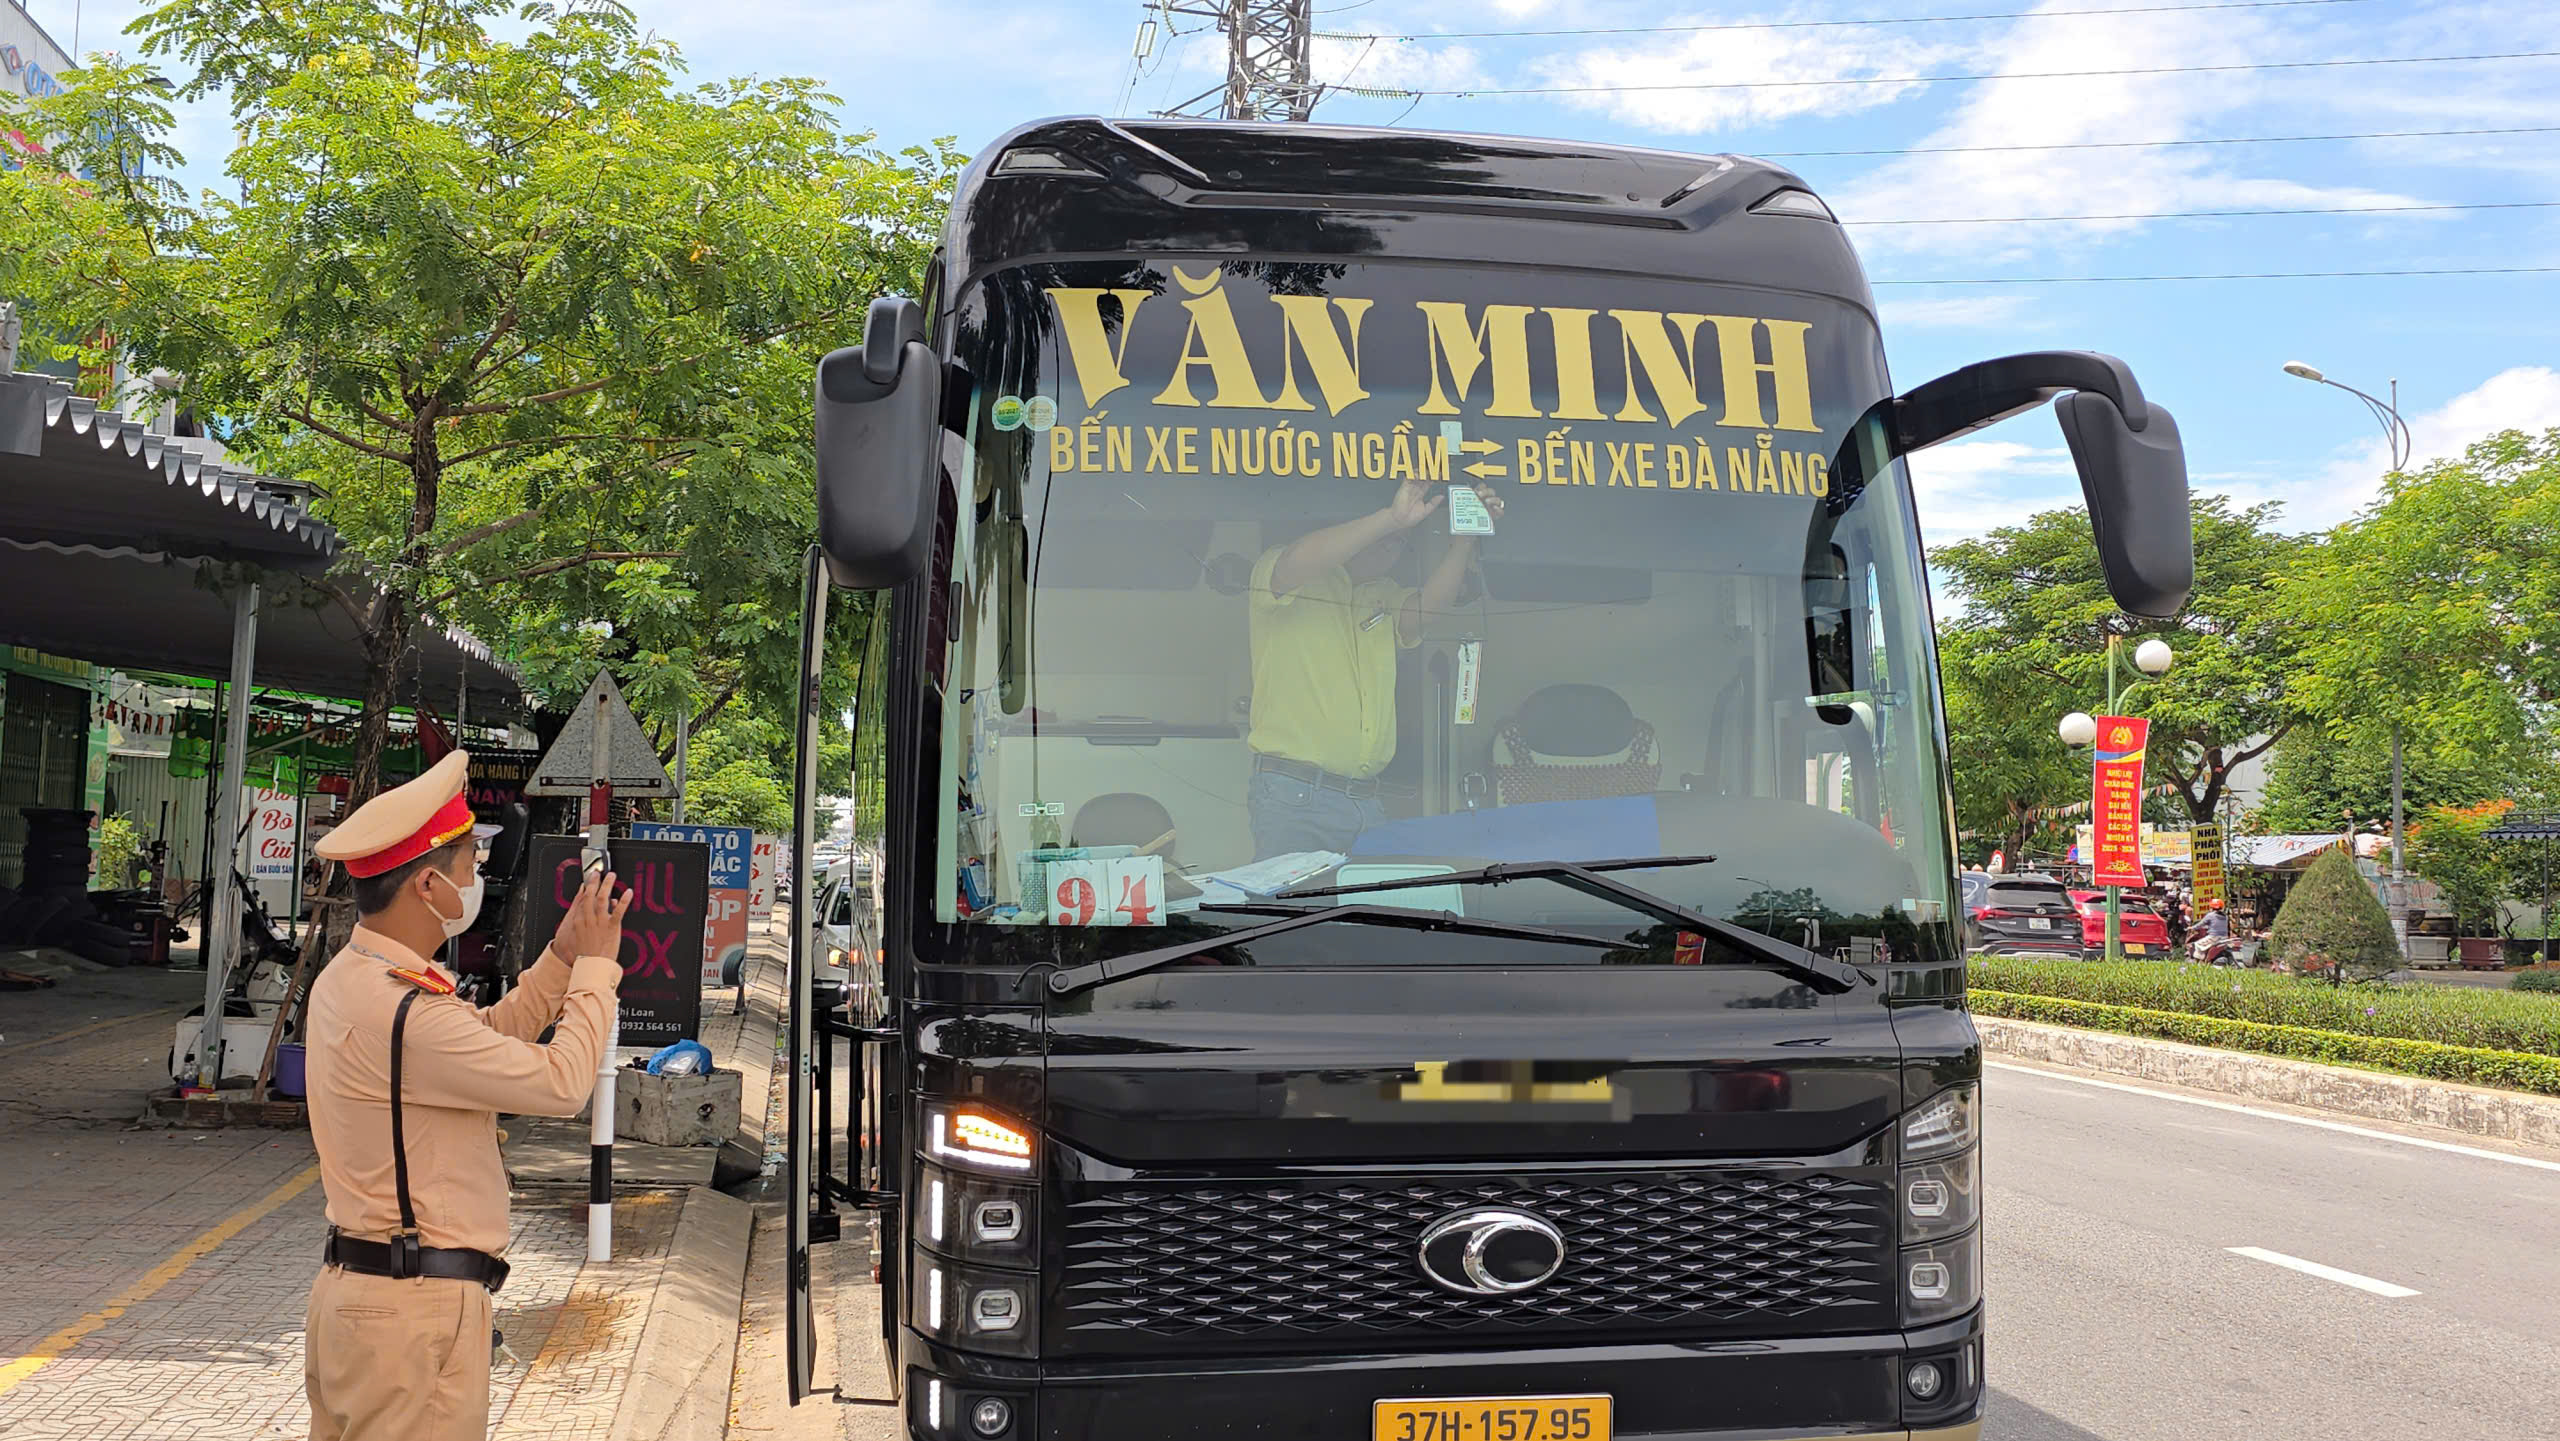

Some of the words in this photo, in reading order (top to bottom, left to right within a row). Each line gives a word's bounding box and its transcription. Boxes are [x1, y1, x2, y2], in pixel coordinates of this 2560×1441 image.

[1044, 265, 1374, 417] VĂN
[1416, 301, 1823, 433] MINH
[1050, 410, 1132, 473] BẾN
[1145, 426, 1199, 474] XE
[1211, 420, 1321, 477] NƯỚC
[1332, 420, 1450, 480] NGẦM
[1517, 426, 1596, 486] BẾN
[1605, 441, 1658, 488] XE
[1666, 436, 1719, 491] ĐÀ
[1727, 434, 1829, 497] NẴNG
[262, 808, 294, 831] Bò
[713, 831, 740, 850] TÔ
[707, 892, 742, 921] ỐP
[630, 1007, 655, 1017] Loan
[621, 1021, 645, 1031] 0932
[646, 1022, 664, 1031] 564
[665, 1023, 682, 1032] 561
[1396, 1407, 1591, 1441] 37H-157.95
